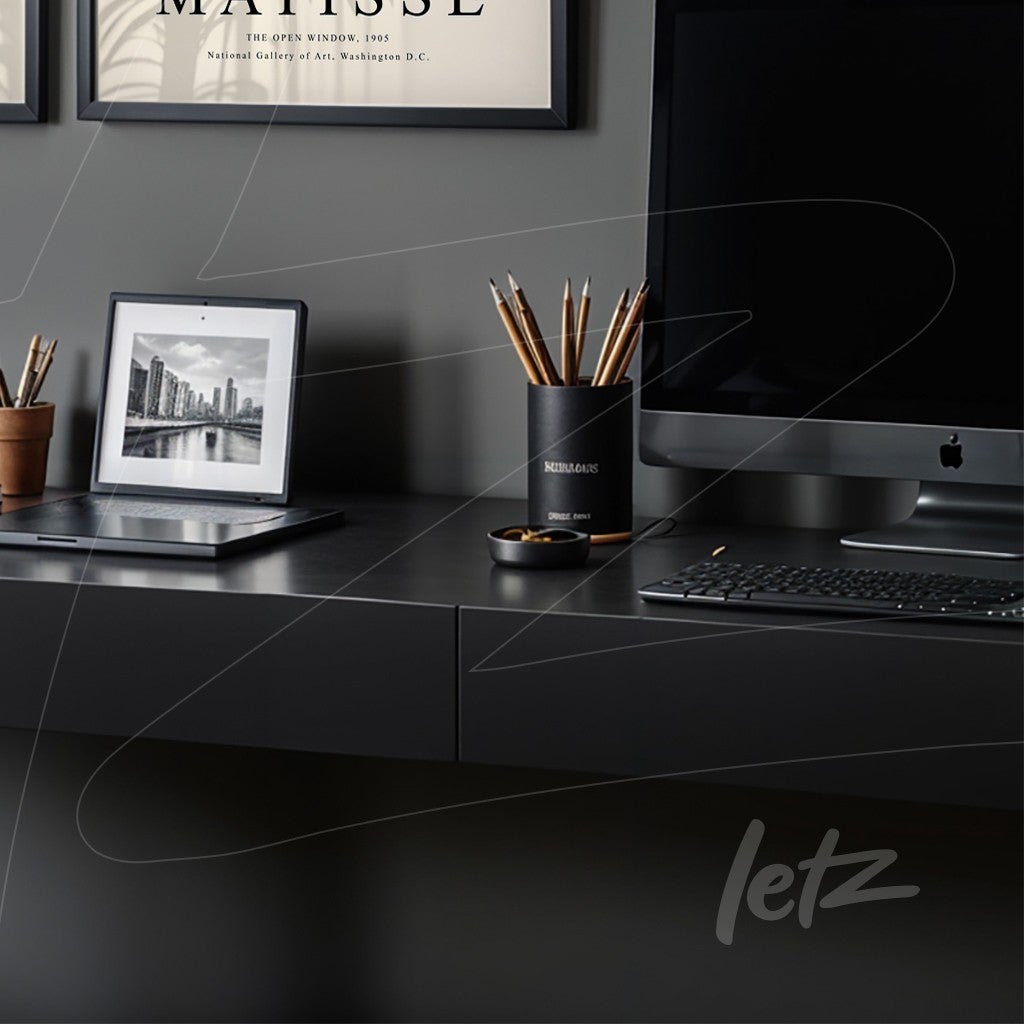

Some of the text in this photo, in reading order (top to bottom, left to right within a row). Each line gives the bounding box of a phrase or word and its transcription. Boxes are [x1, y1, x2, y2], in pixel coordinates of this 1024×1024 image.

[245, 32, 268, 43] THE
[271, 32, 303, 43] OPEN
[365, 33, 390, 43] 1905
[207, 50, 252, 61] National
[255, 50, 295, 62] Gallery
[299, 50, 311, 61] of
[339, 51, 402, 63] Washington
[405, 52, 431, 62] D.C.
